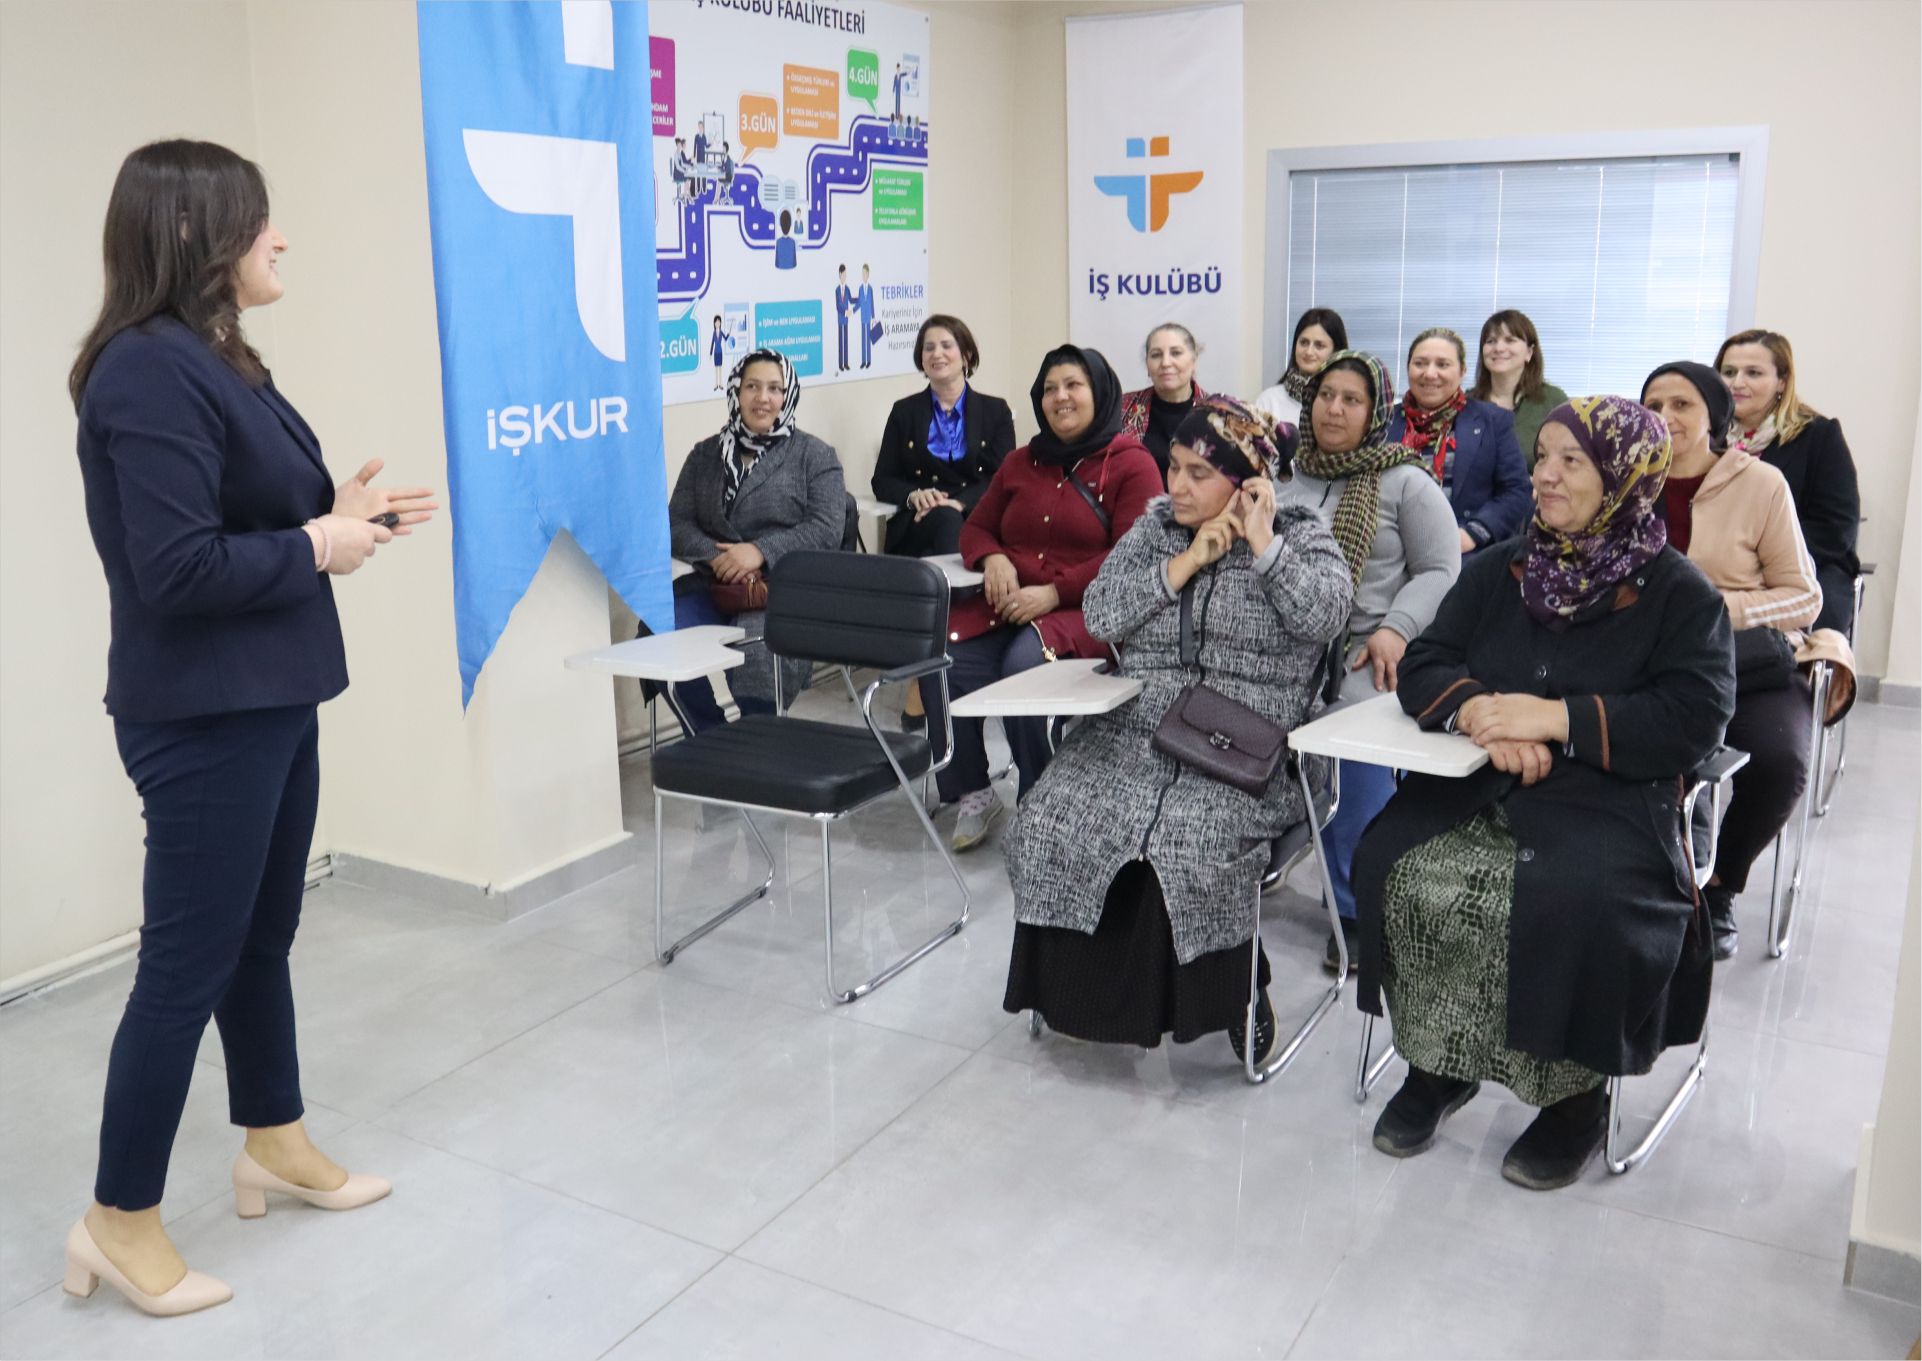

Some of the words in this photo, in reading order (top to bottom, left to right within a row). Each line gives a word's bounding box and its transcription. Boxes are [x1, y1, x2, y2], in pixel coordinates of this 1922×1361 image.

[778, 0, 865, 34] FAALİYETLERİ
[849, 65, 878, 86] 4.GÜN
[652, 115, 673, 126] CERİLER
[741, 112, 776, 133] 3.GÜN
[881, 283, 924, 300] TEBRİKLER
[1089, 268, 1109, 300] İŞ
[1117, 266, 1221, 295] KULÜBÜ
[891, 322, 919, 333] ARAMAYA
[660, 335, 697, 358] 2.GÜN
